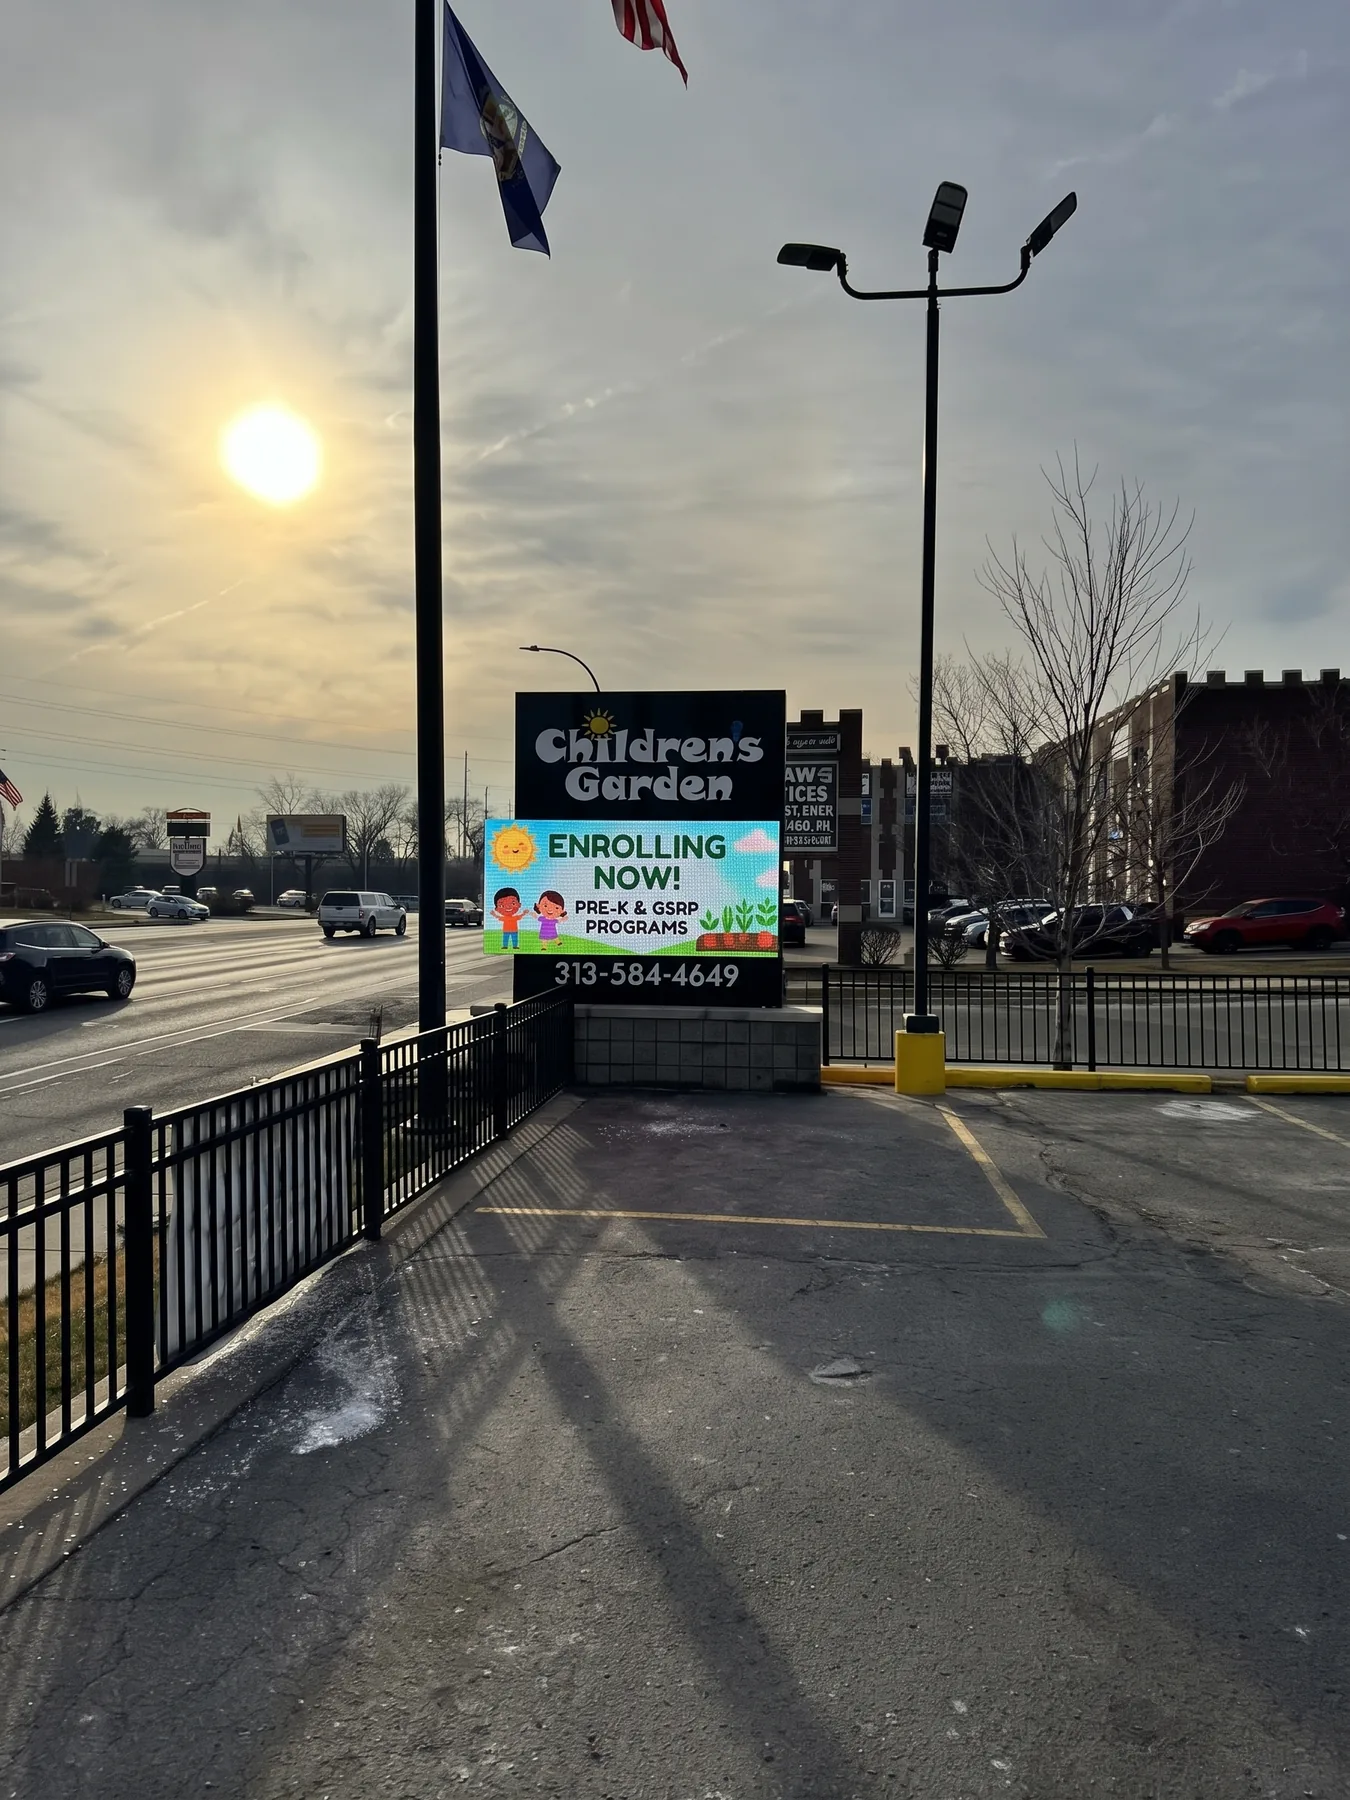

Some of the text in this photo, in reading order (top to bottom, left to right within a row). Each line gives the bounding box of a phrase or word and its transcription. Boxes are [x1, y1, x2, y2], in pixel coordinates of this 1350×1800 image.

[565, 766, 733, 801] Garden
[549, 834, 726, 859] ENROLLING
[594, 866, 680, 890] NOW!
[575, 900, 699, 916] PRE-K & GSRP
[585, 920, 688, 935] PROGRAMS
[554, 961, 740, 988] 313-584-4649
